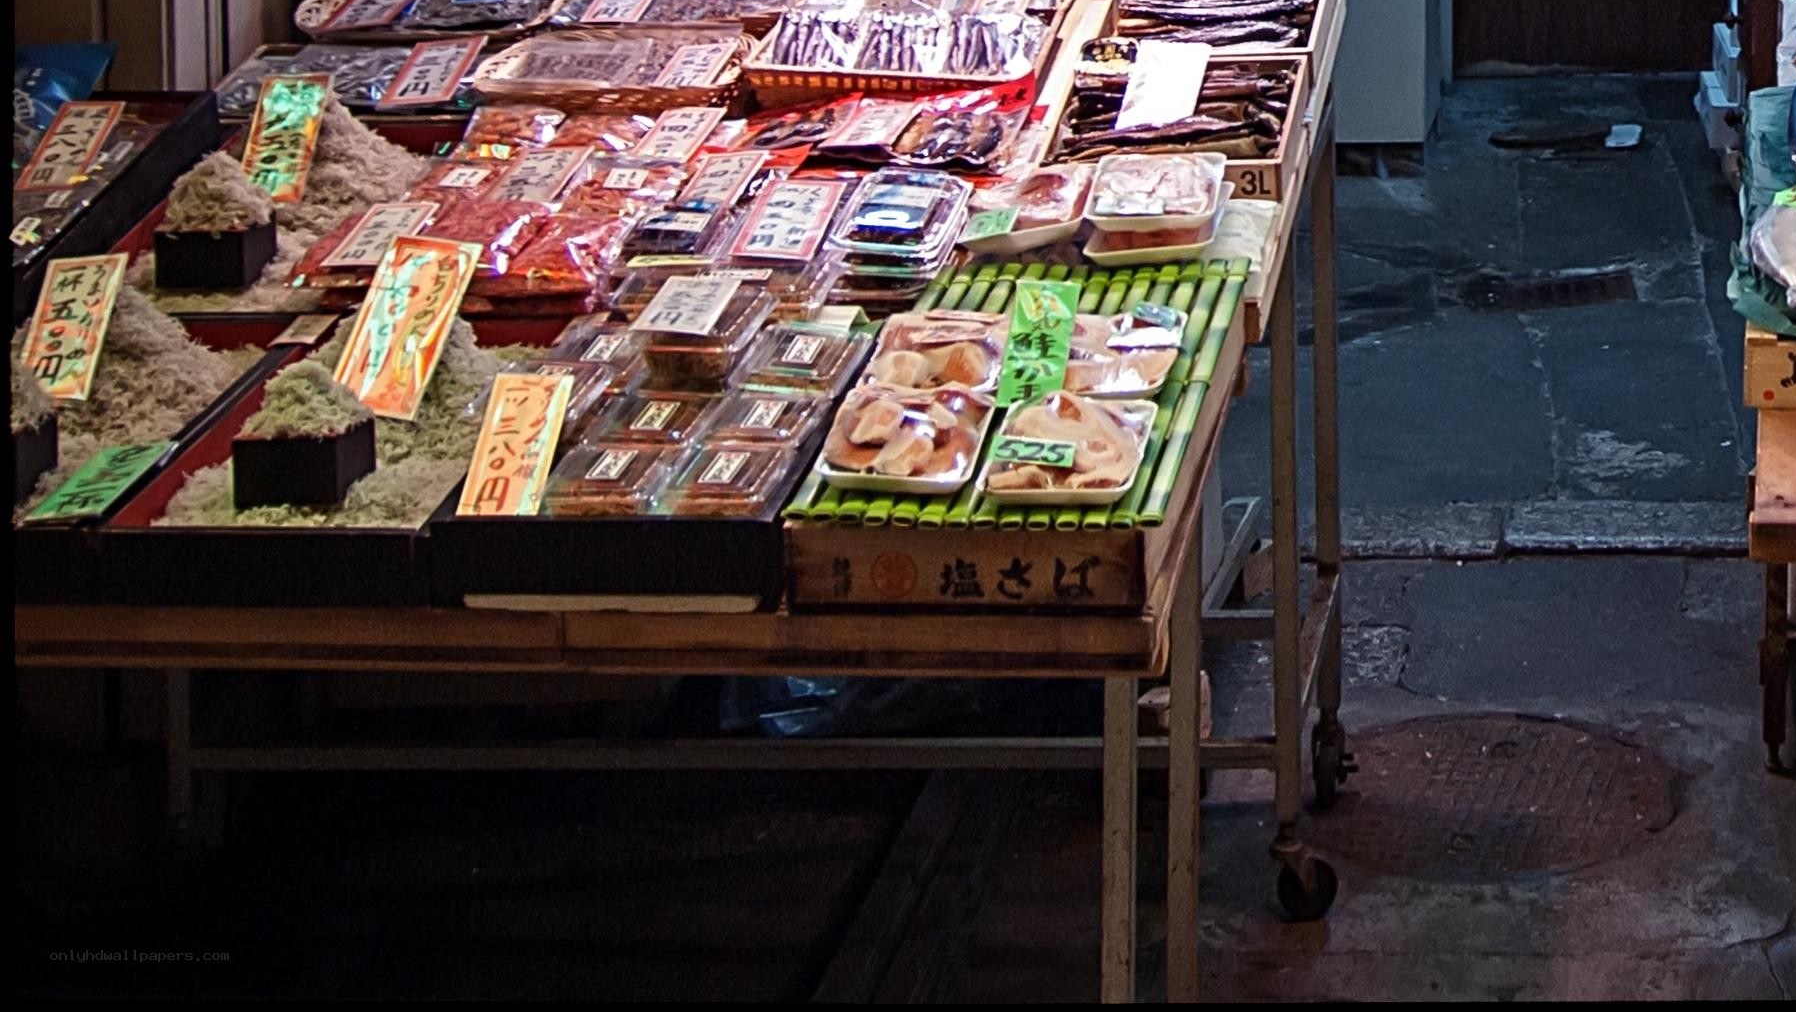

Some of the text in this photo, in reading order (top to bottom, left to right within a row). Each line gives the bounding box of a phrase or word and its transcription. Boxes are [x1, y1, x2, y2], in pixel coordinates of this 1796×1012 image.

[1240, 169, 1272, 197] 3L
[994, 440, 1074, 465] 525
[940, 556, 1102, 600] 塩さば
